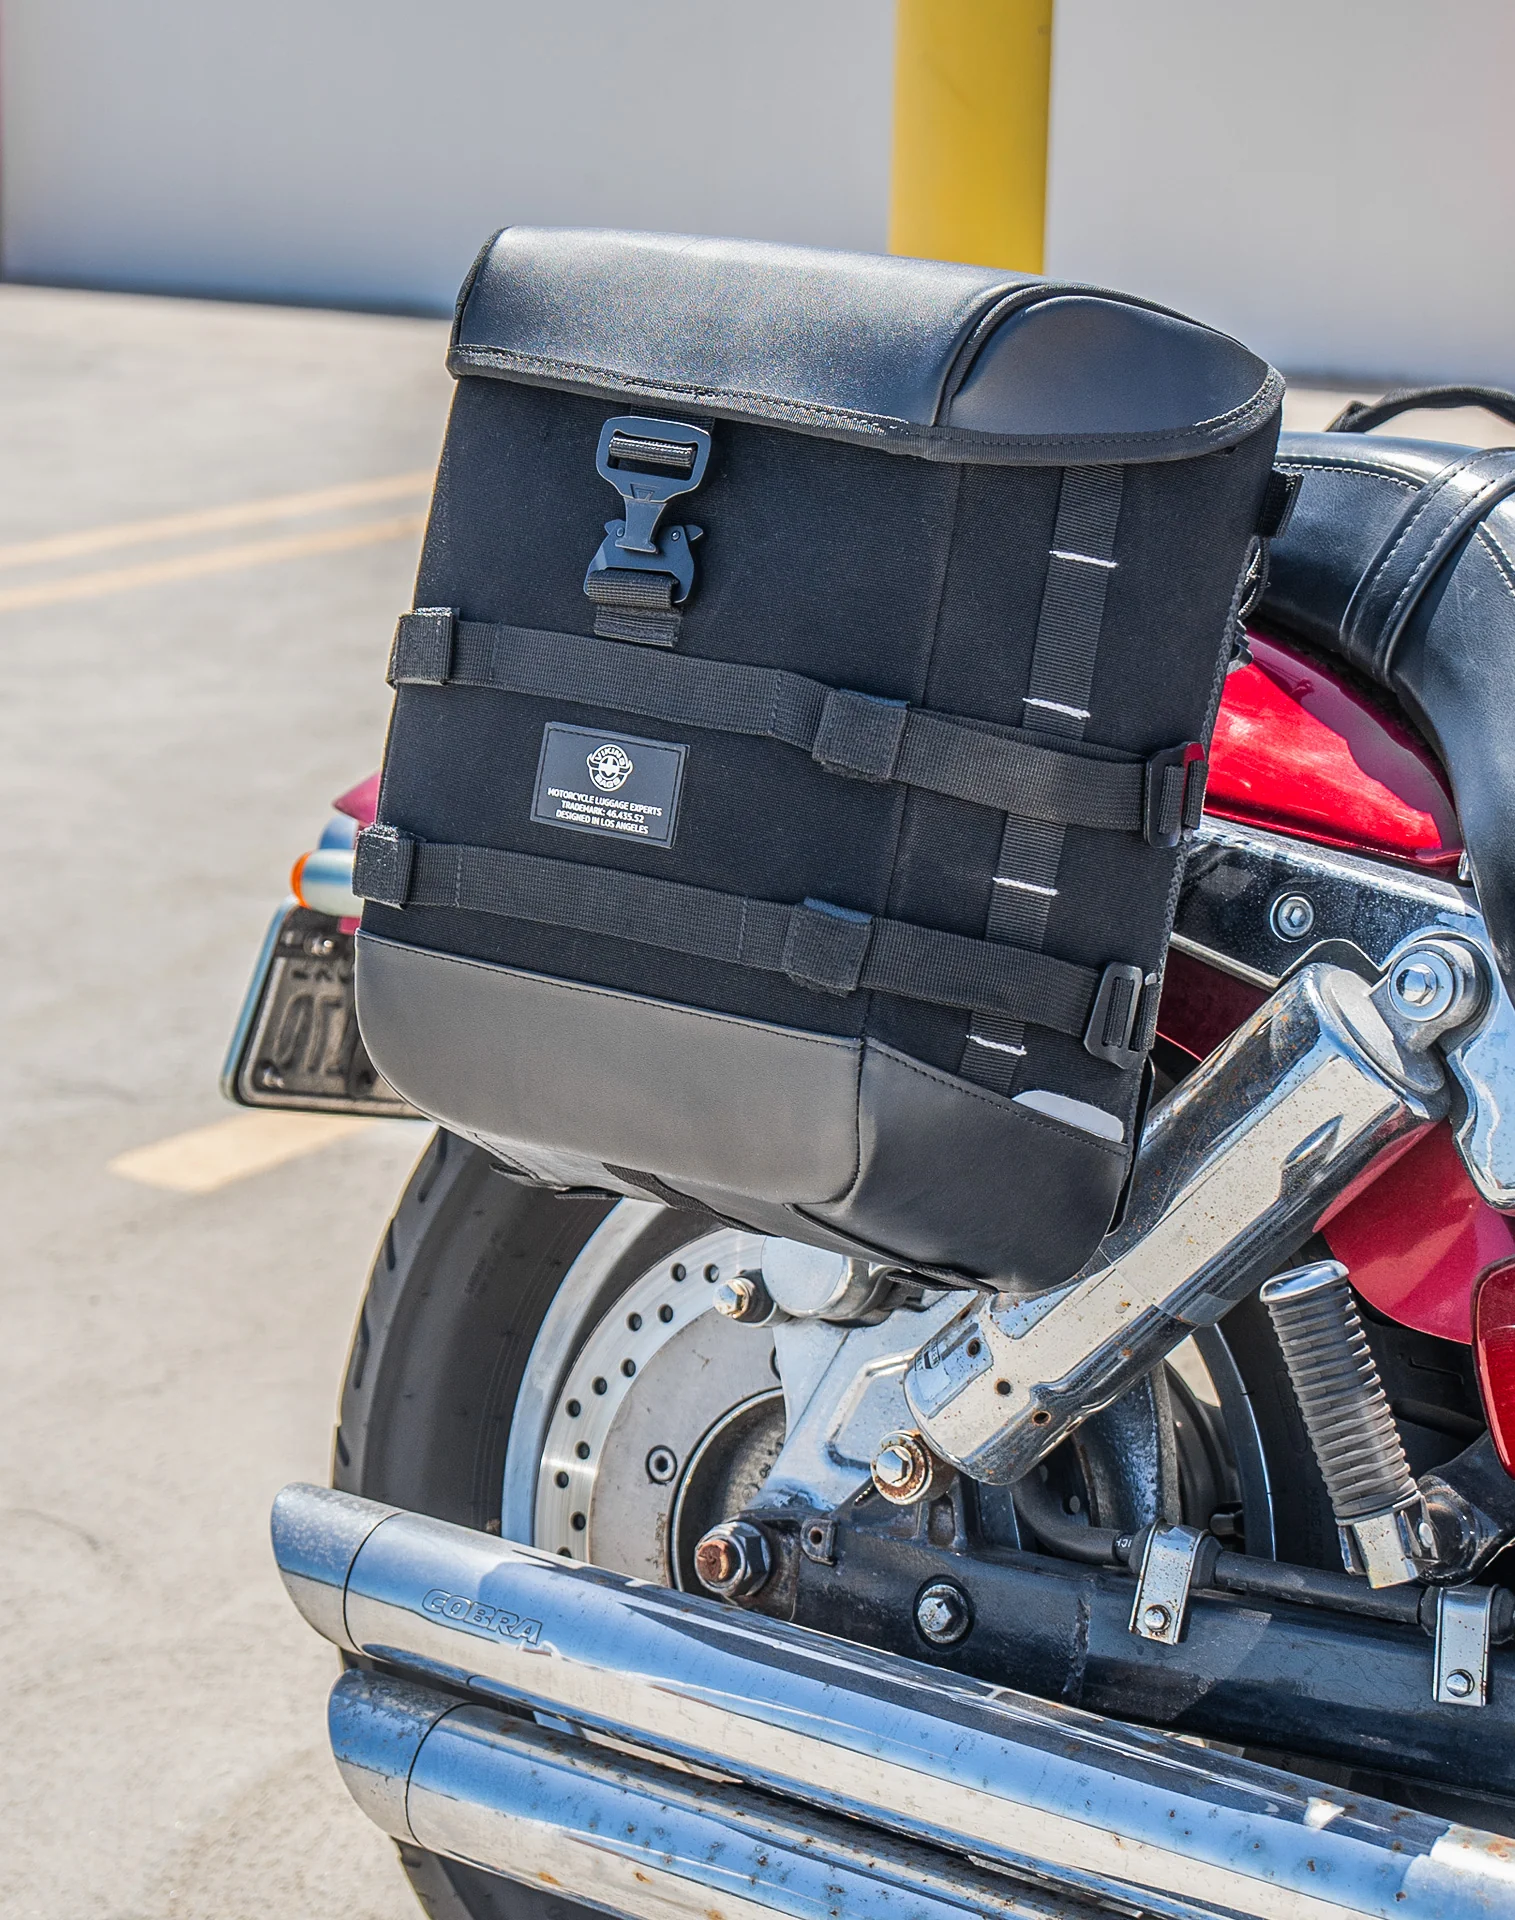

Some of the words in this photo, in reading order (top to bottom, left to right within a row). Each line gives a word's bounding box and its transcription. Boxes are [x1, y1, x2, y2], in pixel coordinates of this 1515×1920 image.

[594, 747, 626, 766] VIKING
[594, 773, 621, 788] BAGS
[548, 788, 594, 803] MOTORCYCLE
[595, 796, 629, 811] LUGGAGE
[630, 803, 662, 817] EXPERTS
[561, 800, 605, 816] TRADEMARK:
[607, 809, 645, 823] 46.435.52
[556, 810, 591, 823] DESIGNED
[591, 817, 600, 825] IN
[601, 818, 615, 828] LOS
[615, 821, 649, 834] ANGELES
[421, 1588, 543, 1646] COBRA
